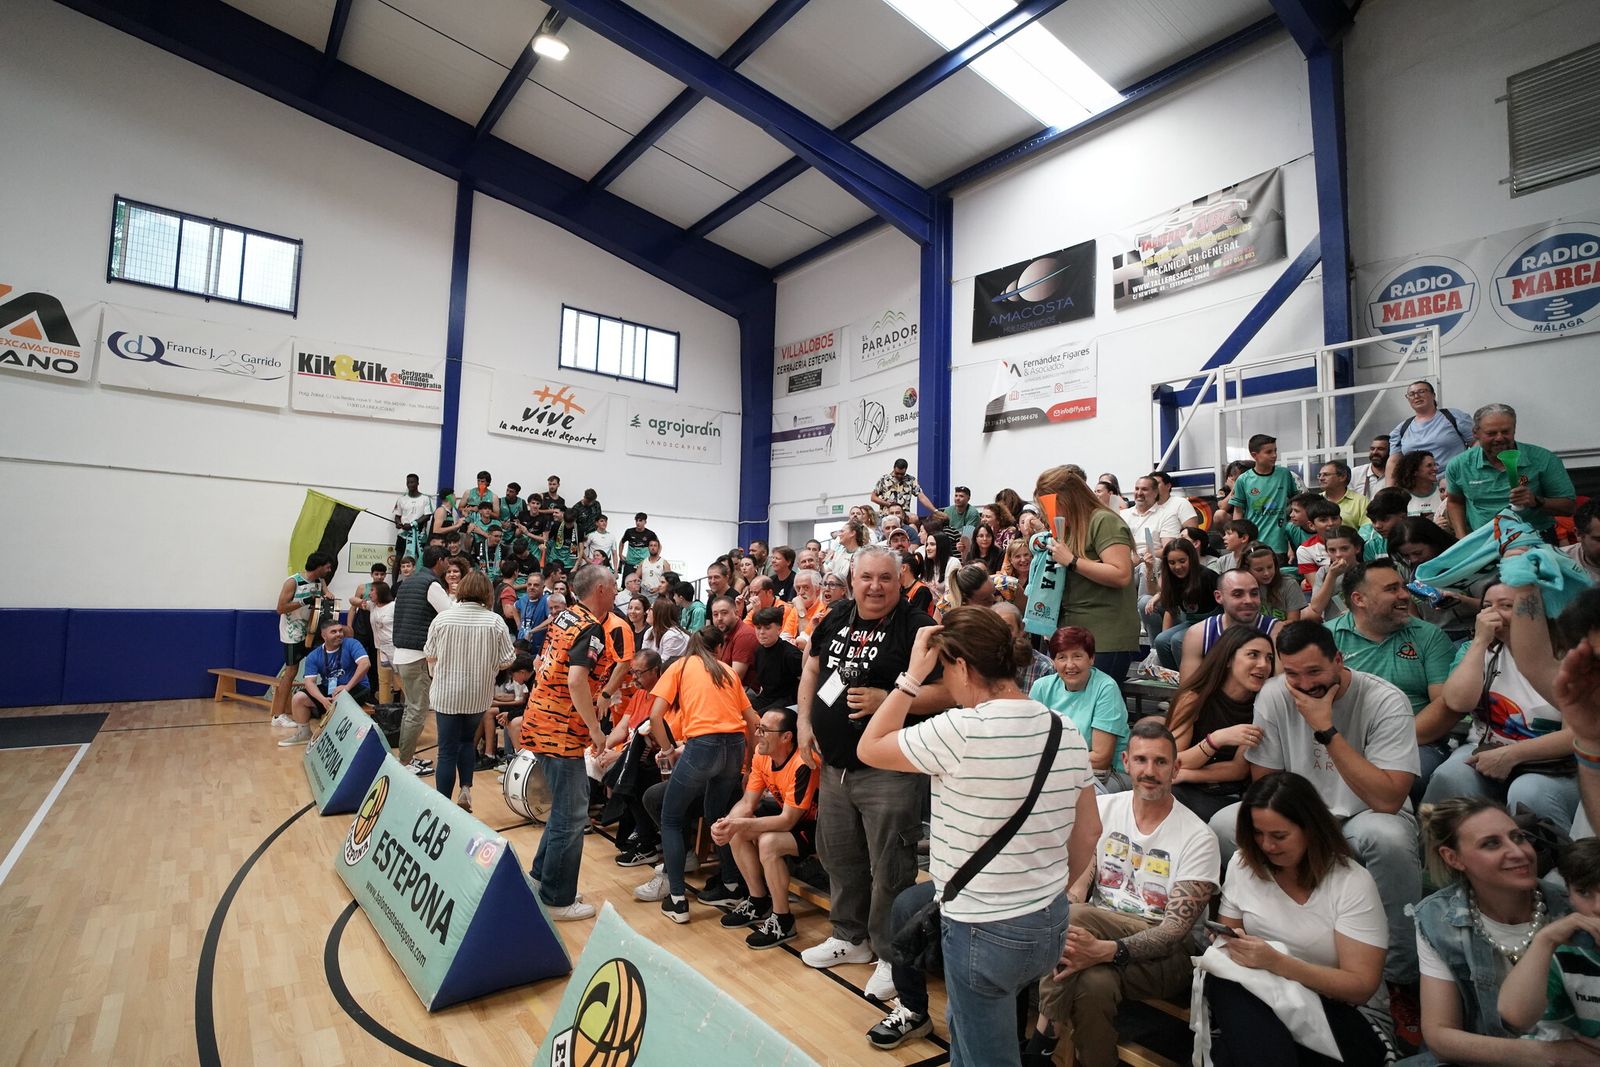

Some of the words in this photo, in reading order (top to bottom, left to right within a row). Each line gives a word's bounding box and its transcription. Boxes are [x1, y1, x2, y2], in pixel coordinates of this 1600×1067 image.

[1188, 252, 1199, 264] EN
[1201, 240, 1240, 260] GENERAL
[1521, 240, 1599, 272] RADIO
[1132, 263, 1210, 294] WWW.TALLERESABC.COM
[1389, 273, 1453, 298] RADIO
[988, 296, 1074, 327] AMACOSTA
[1382, 289, 1463, 324] MARCA
[1532, 317, 1585, 333] MÁLAGA
[166, 341, 207, 356] Francis
[209, 348, 216, 360] J.
[781, 332, 834, 360] VILLALOBOS
[861, 323, 918, 354] PARADOR
[241, 353, 282, 368] Garrido
[808, 351, 837, 366] ESTEPONA
[1062, 347, 1090, 360] Figares
[298, 352, 337, 377] Kik
[352, 359, 388, 383] Kik
[1030, 362, 1065, 376] Asociados
[648, 418, 721, 438] agrojardín
[894, 412, 909, 424] FIBA
[499, 421, 507, 430] la
[510, 424, 540, 437] marca
[542, 429, 556, 439] del
[558, 431, 598, 446] deporte
[829, 639, 844, 655] TU
[335, 716, 352, 742] CAB
[316, 731, 344, 781] ESTEPONA
[411, 808, 451, 862] CAB
[371, 829, 456, 946] ESTEPONA
